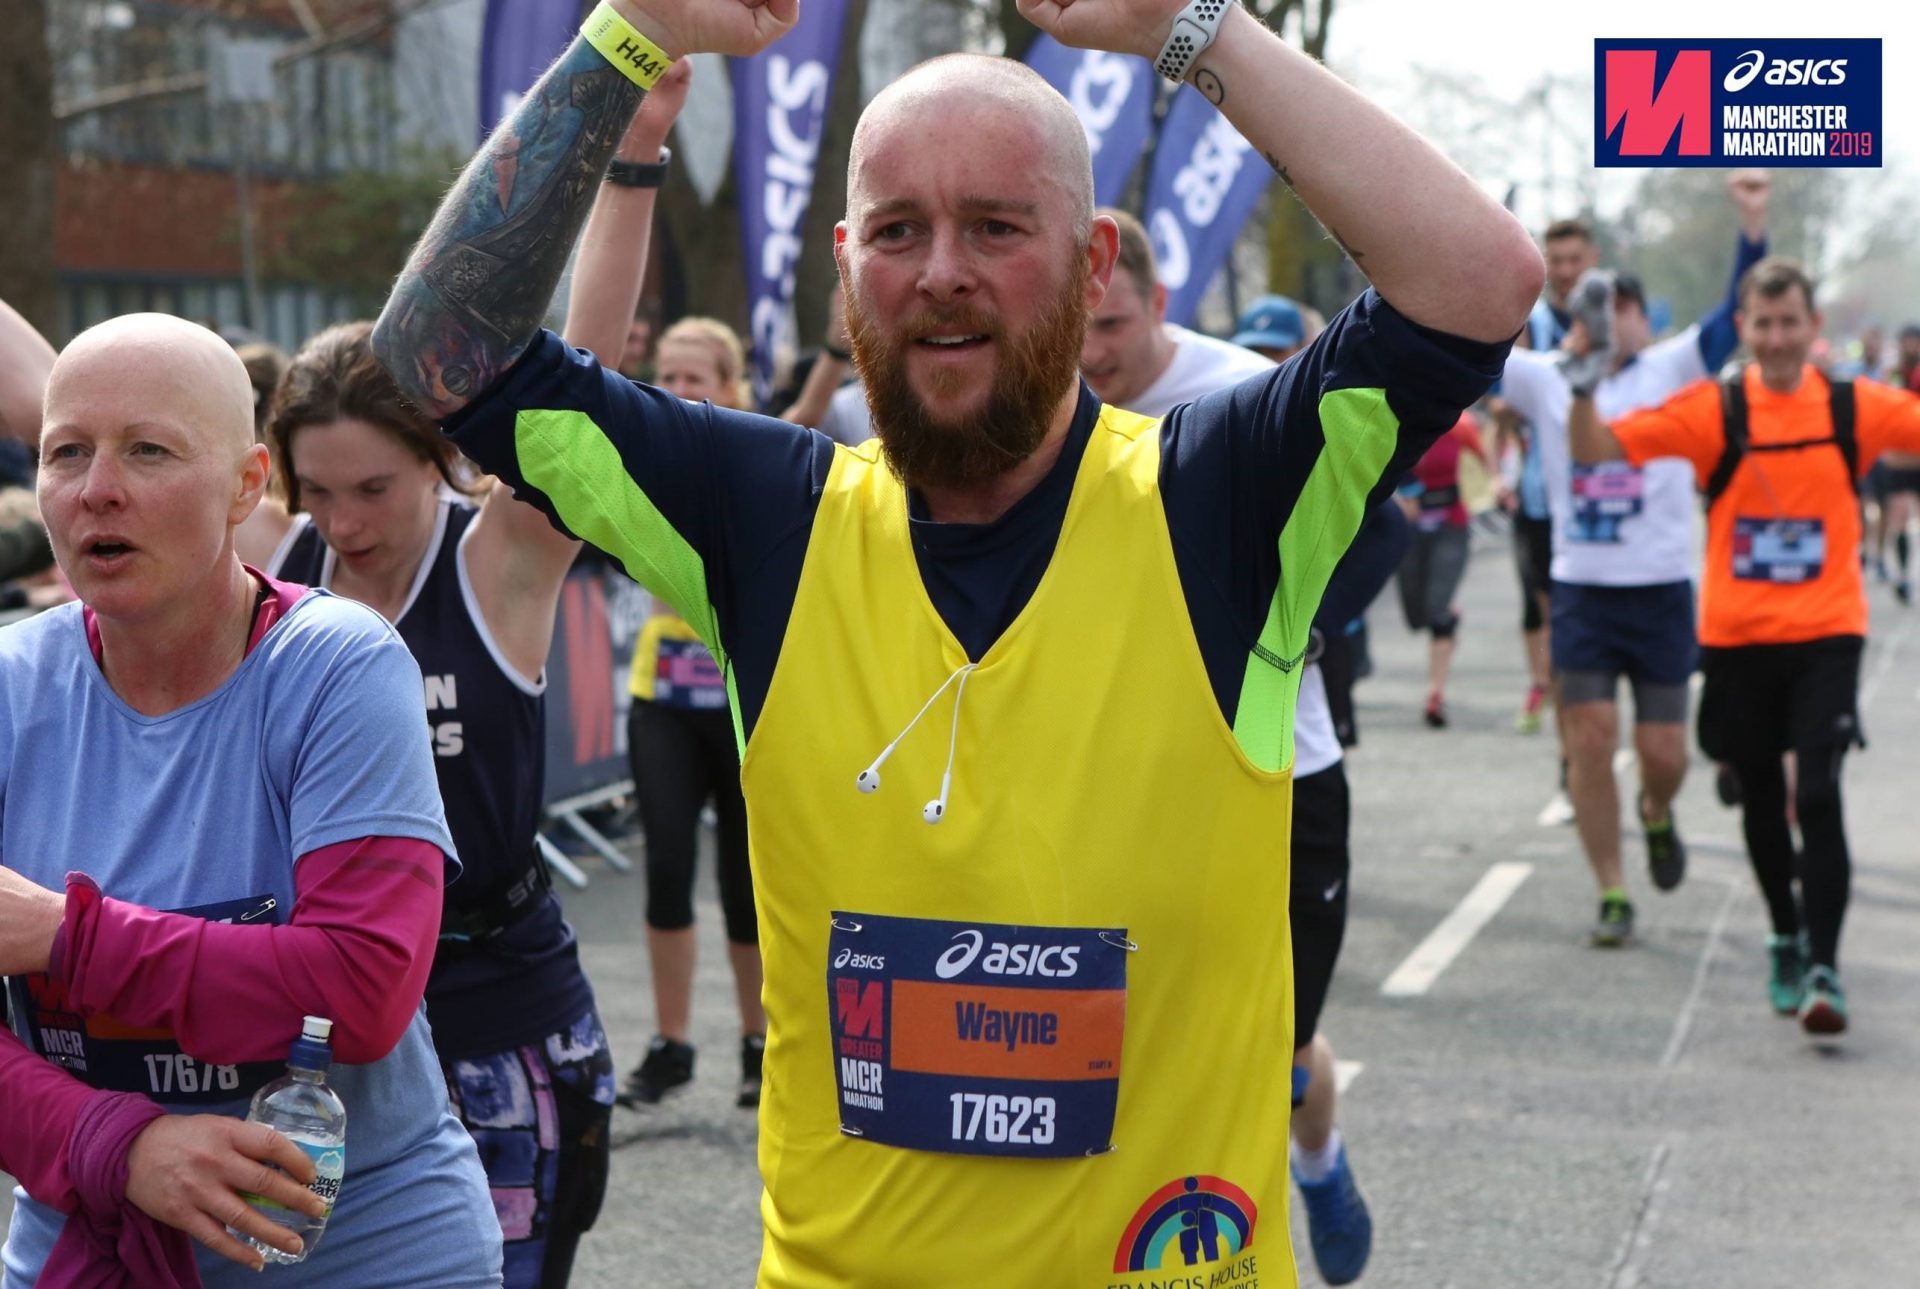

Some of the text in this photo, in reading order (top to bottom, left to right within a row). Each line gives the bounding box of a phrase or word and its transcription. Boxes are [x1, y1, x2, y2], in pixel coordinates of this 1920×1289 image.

[40, 1027, 86, 1058] MCR
[955, 1001, 1057, 1052] Wayne
[840, 1057, 883, 1095] MCR
[844, 1090, 884, 1112] MARATHON
[950, 1092, 1056, 1145] 17623
[1211, 1256, 1257, 1289] HOUSE
